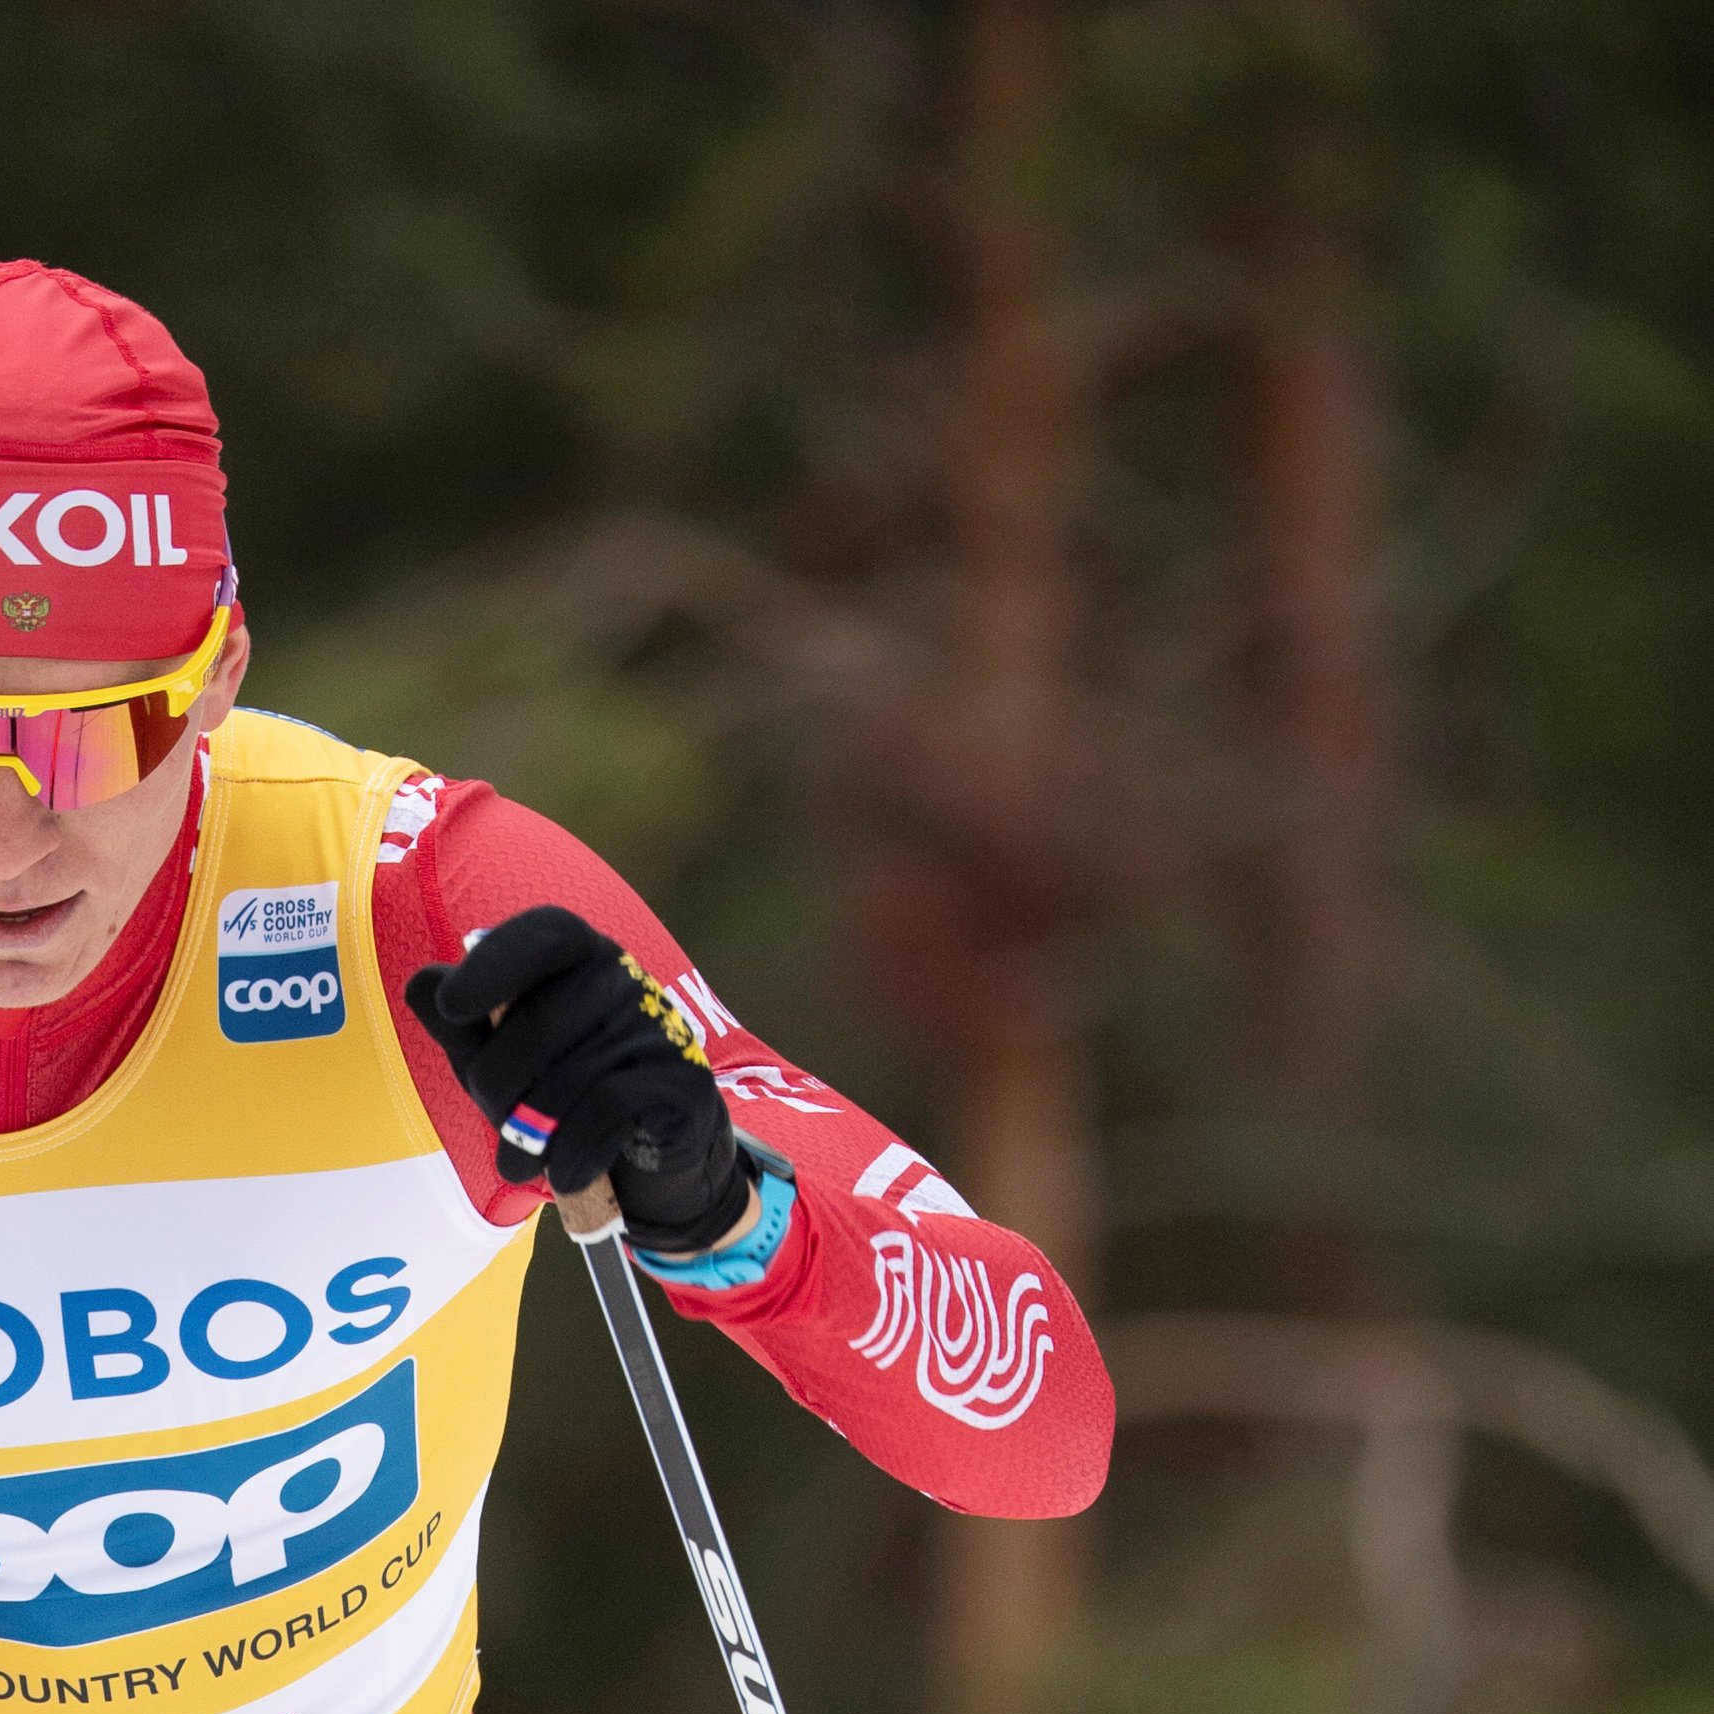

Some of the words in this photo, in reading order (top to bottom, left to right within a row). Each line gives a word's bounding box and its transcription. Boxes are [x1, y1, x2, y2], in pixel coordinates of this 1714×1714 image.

[263, 898, 316, 916] CROSS
[263, 910, 333, 931] COUNTRY
[264, 930, 305, 943] WORLD
[308, 925, 329, 938] CUP
[224, 971, 338, 1015] coop
[202, 1584, 368, 1678] WORLD
[380, 1510, 442, 1590] CUP
